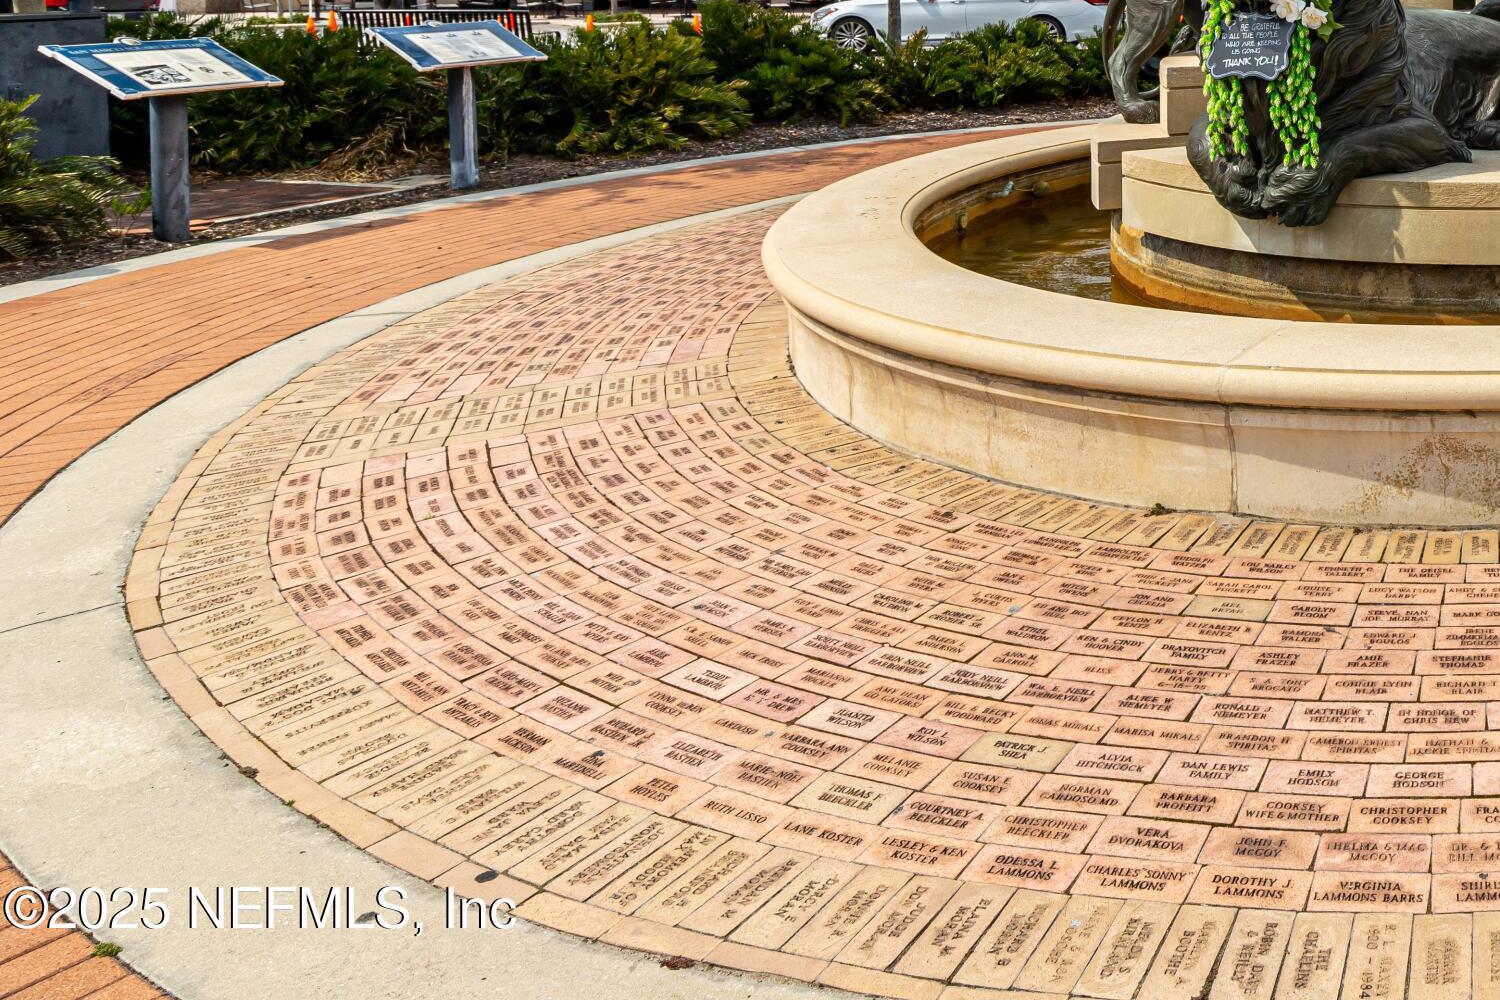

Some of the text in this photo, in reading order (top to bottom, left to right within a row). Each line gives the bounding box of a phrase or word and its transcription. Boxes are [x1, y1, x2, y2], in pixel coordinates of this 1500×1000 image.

[1251, 23, 1280, 31] GRATEFUL
[1222, 55, 1279, 68] THANK YOU!
[513, 728, 551, 746] HERMAN
[498, 735, 539, 754] JACKSON
[993, 739, 1037, 752] PATRICK
[998, 749, 1027, 760] SHEA
[1214, 762, 1249, 773] LEWIS
[1188, 768, 1233, 781] FAMILY
[1395, 772, 1444, 780] GEORGE
[1392, 779, 1446, 788] HODSON
[1159, 791, 1217, 804] BARBARA
[704, 800, 768, 824] RUTH LISSO
[1360, 806, 1448, 815] CHRISTOPHER
[1373, 815, 1433, 825] COOKSEY
[783, 821, 864, 848] LANE KOSTER
[1136, 827, 1170, 839] VERA
[881, 836, 929, 853] LESLEY
[941, 844, 968, 859] KEN
[1108, 835, 1184, 852] DVORAKOVA
[890, 850, 939, 866] KOSTER
[1086, 864, 1141, 878] CHARLES
[1100, 878, 1166, 892] LAMMONS
[1211, 874, 1278, 888] DOROTHY
[1339, 881, 1402, 891] VIRGINIA
[1213, 886, 1284, 900] LAMMONS
[1313, 890, 1424, 903] LAMMONS BARRS
